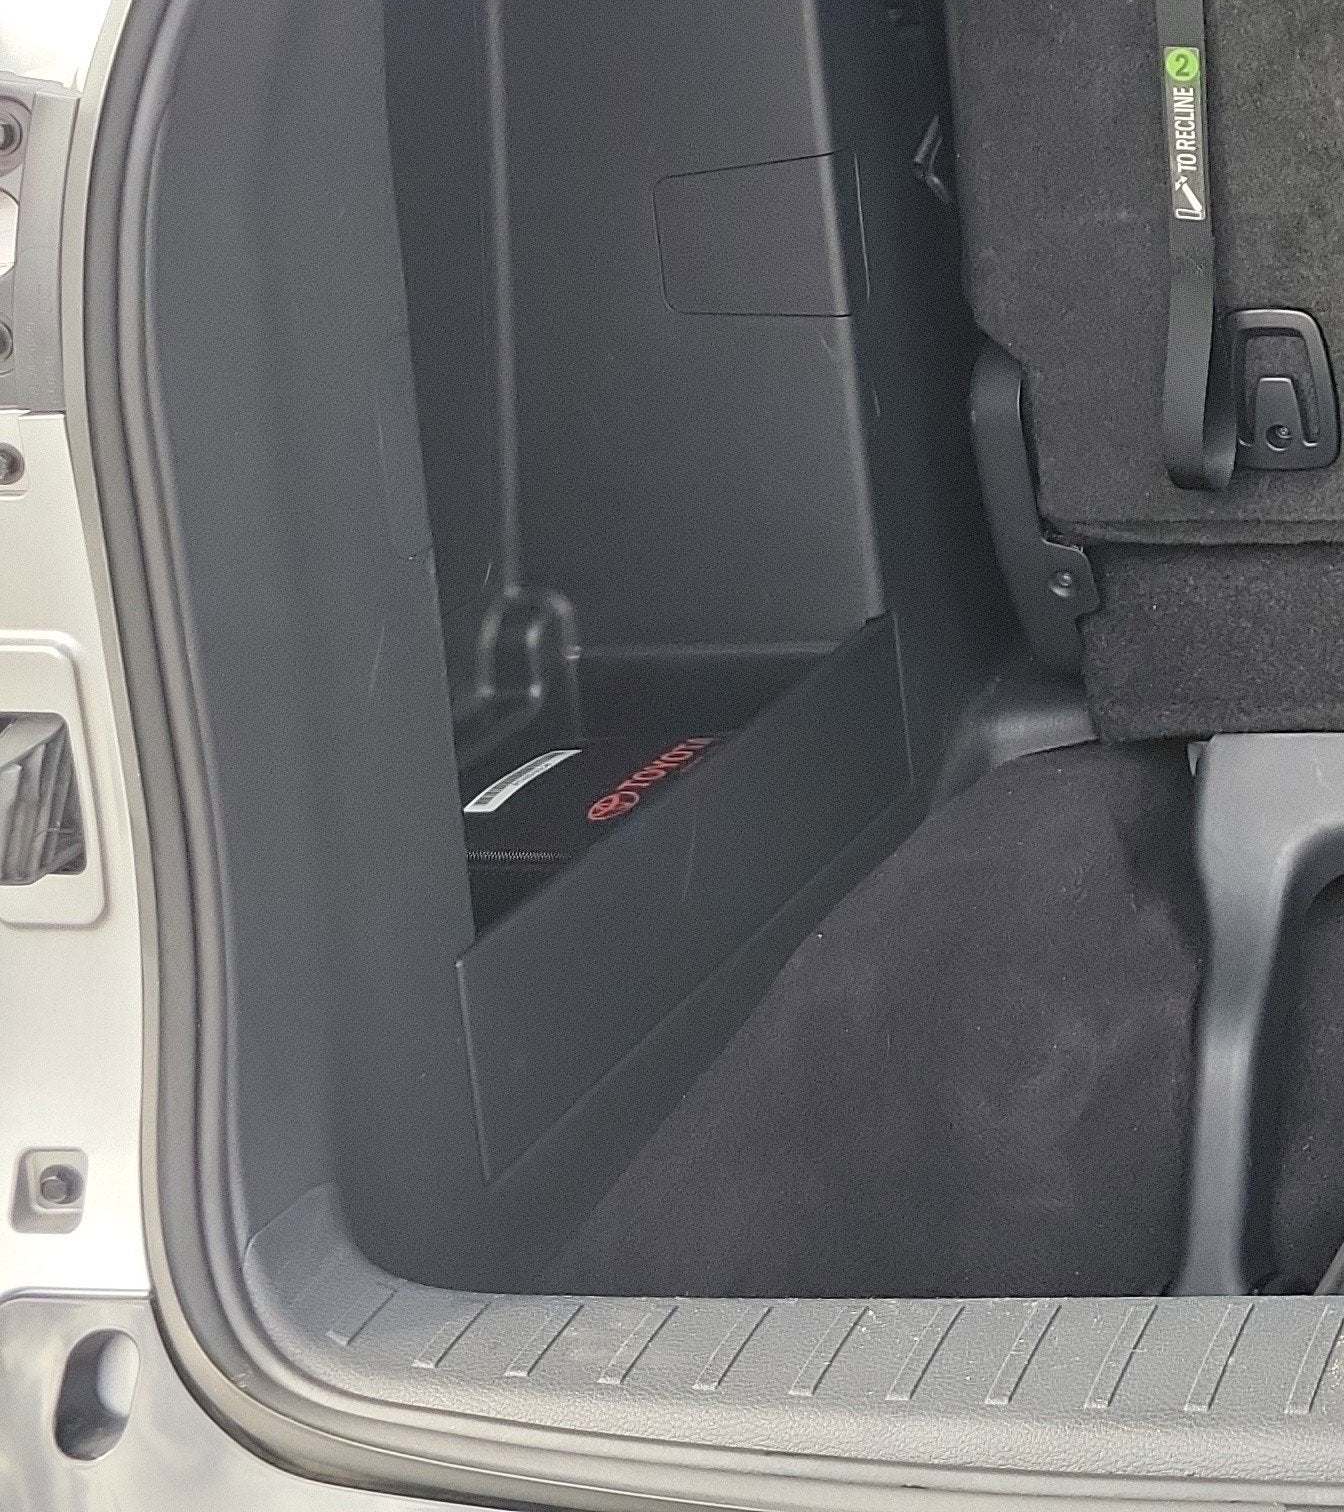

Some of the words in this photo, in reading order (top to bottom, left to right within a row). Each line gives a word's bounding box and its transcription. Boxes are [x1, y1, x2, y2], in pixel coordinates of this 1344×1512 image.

[1175, 54, 1190, 77] 2
[1173, 87, 1197, 151] RECLINE
[1178, 153, 1197, 172] TO
